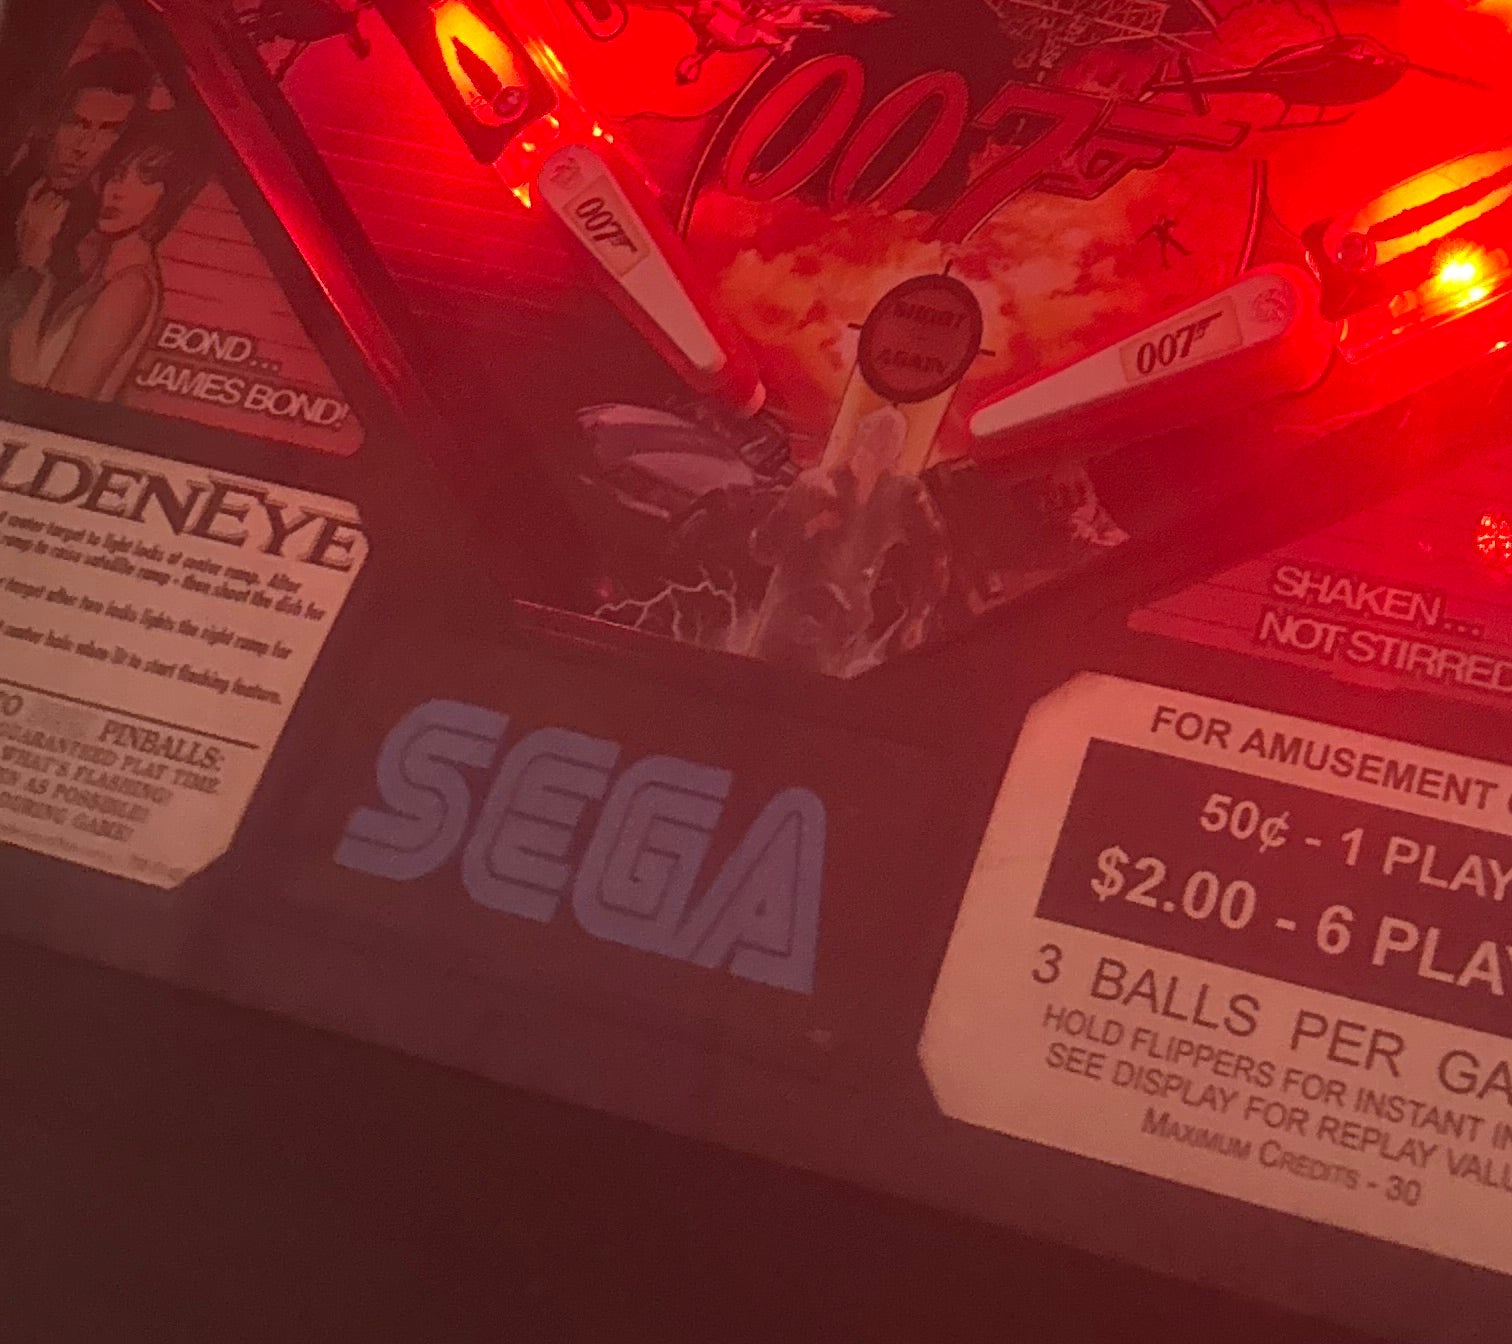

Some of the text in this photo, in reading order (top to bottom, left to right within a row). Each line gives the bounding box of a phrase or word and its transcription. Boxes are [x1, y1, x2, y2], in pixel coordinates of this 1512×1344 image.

[572, 195, 638, 258] 007
[156, 322, 281, 375] BOND...
[1135, 312, 1224, 376] 007
[135, 360, 350, 430] JAMES BOND!
[1258, 611, 1347, 654] NOT
[1272, 563, 1484, 638] SHAKEN...
[1151, 705, 1231, 750] FOR
[1240, 727, 1498, 812] AMUSEMENT
[334, 698, 827, 995] SEGA
[1200, 793, 1290, 854] 50¢
[1341, 828, 1361, 867] 1
[1089, 844, 1259, 930] $2.00
[1316, 905, 1353, 955] 6
[1031, 943, 1062, 987] 3
[1091, 958, 1261, 1038] BALLS
[1290, 1010, 1406, 1077] PER
[1043, 1003, 1124, 1050] HOLD
[1130, 1025, 1275, 1091] FLIPPERS
[1281, 1063, 1347, 1106] FOR
[1353, 1086, 1484, 1144] INSTANT
[1046, 1042, 1104, 1085] SEE
[1111, 1059, 1236, 1121] DISPLAY
[1244, 1093, 1310, 1137] FOR
[1316, 1114, 1439, 1175] REPLAY
[1385, 1173, 1422, 1206] 30
